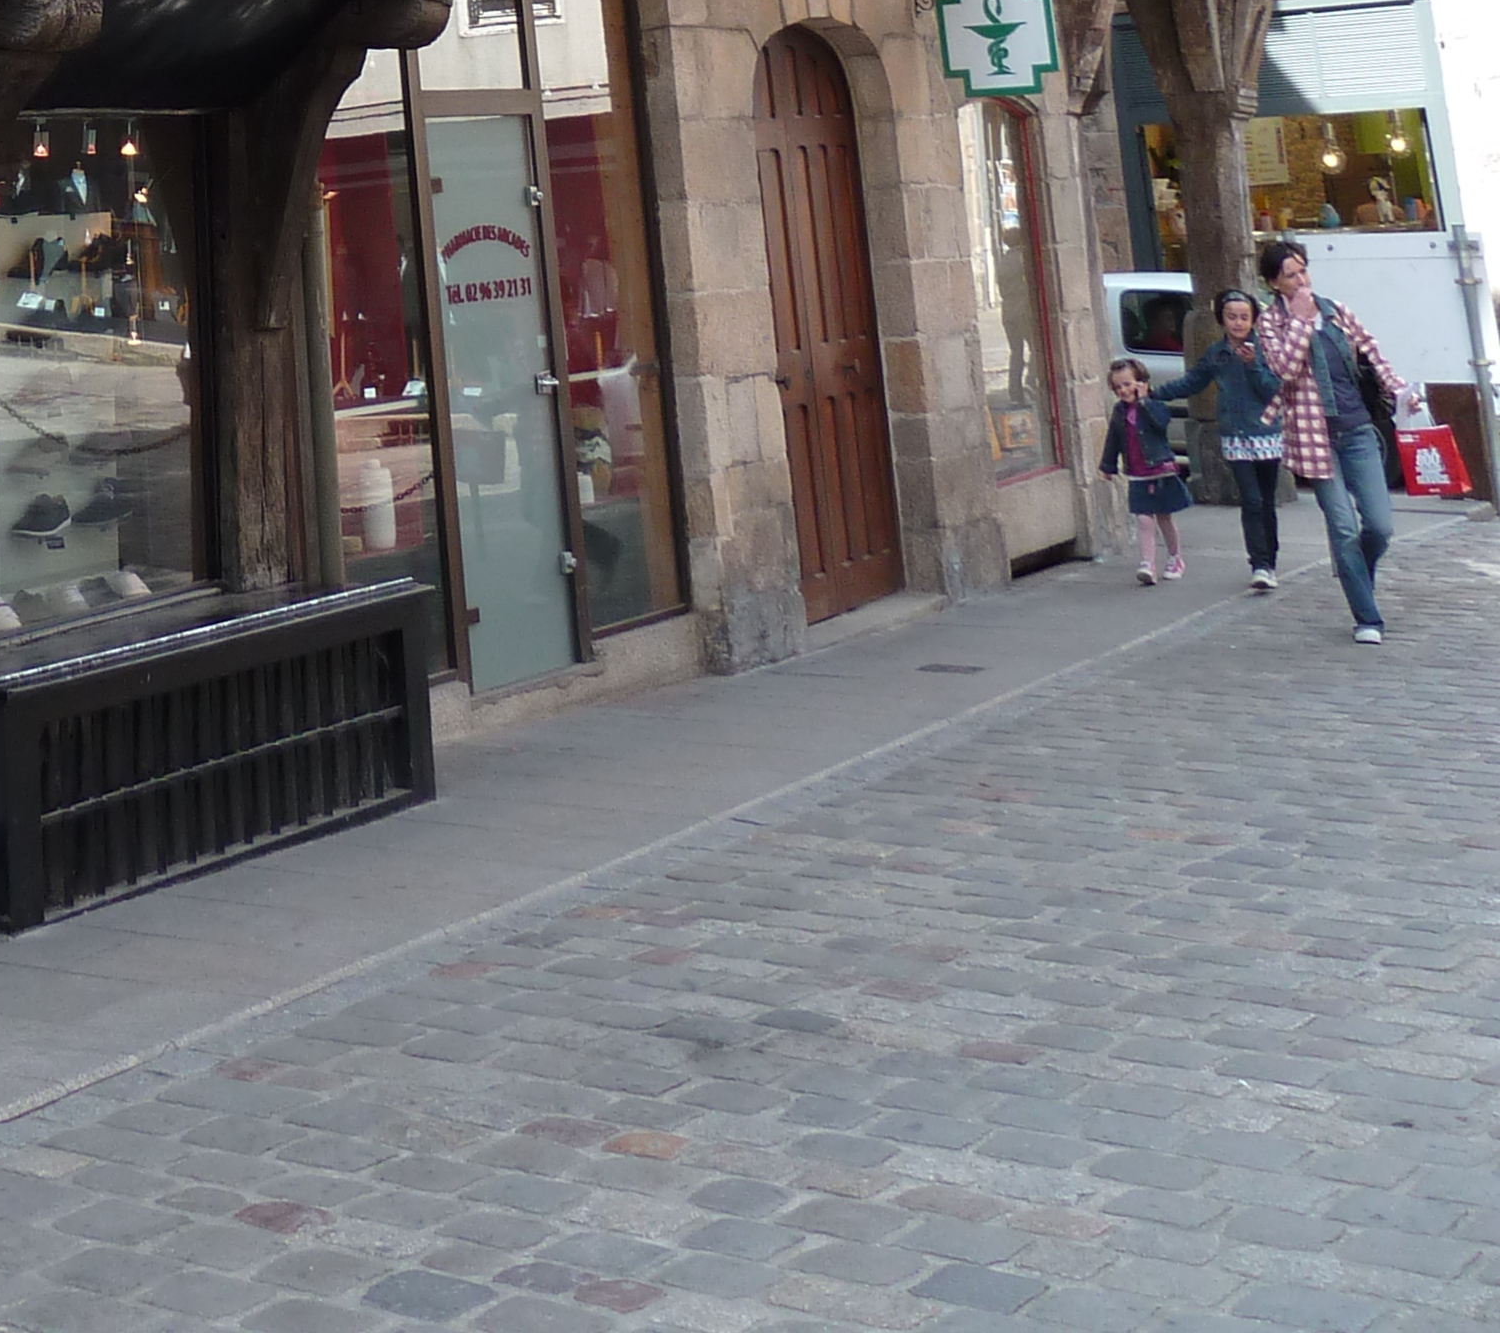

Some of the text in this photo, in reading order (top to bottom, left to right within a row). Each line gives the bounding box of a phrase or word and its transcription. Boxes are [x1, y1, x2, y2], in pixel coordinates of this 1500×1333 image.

[441, 225, 531, 264] PHARMACIE DES ARCADES
[465, 283, 479, 302] 02
[479, 281, 493, 301] 96
[492, 280, 506, 299] 39
[506, 278, 519, 298] 21
[519, 277, 532, 296] 31
